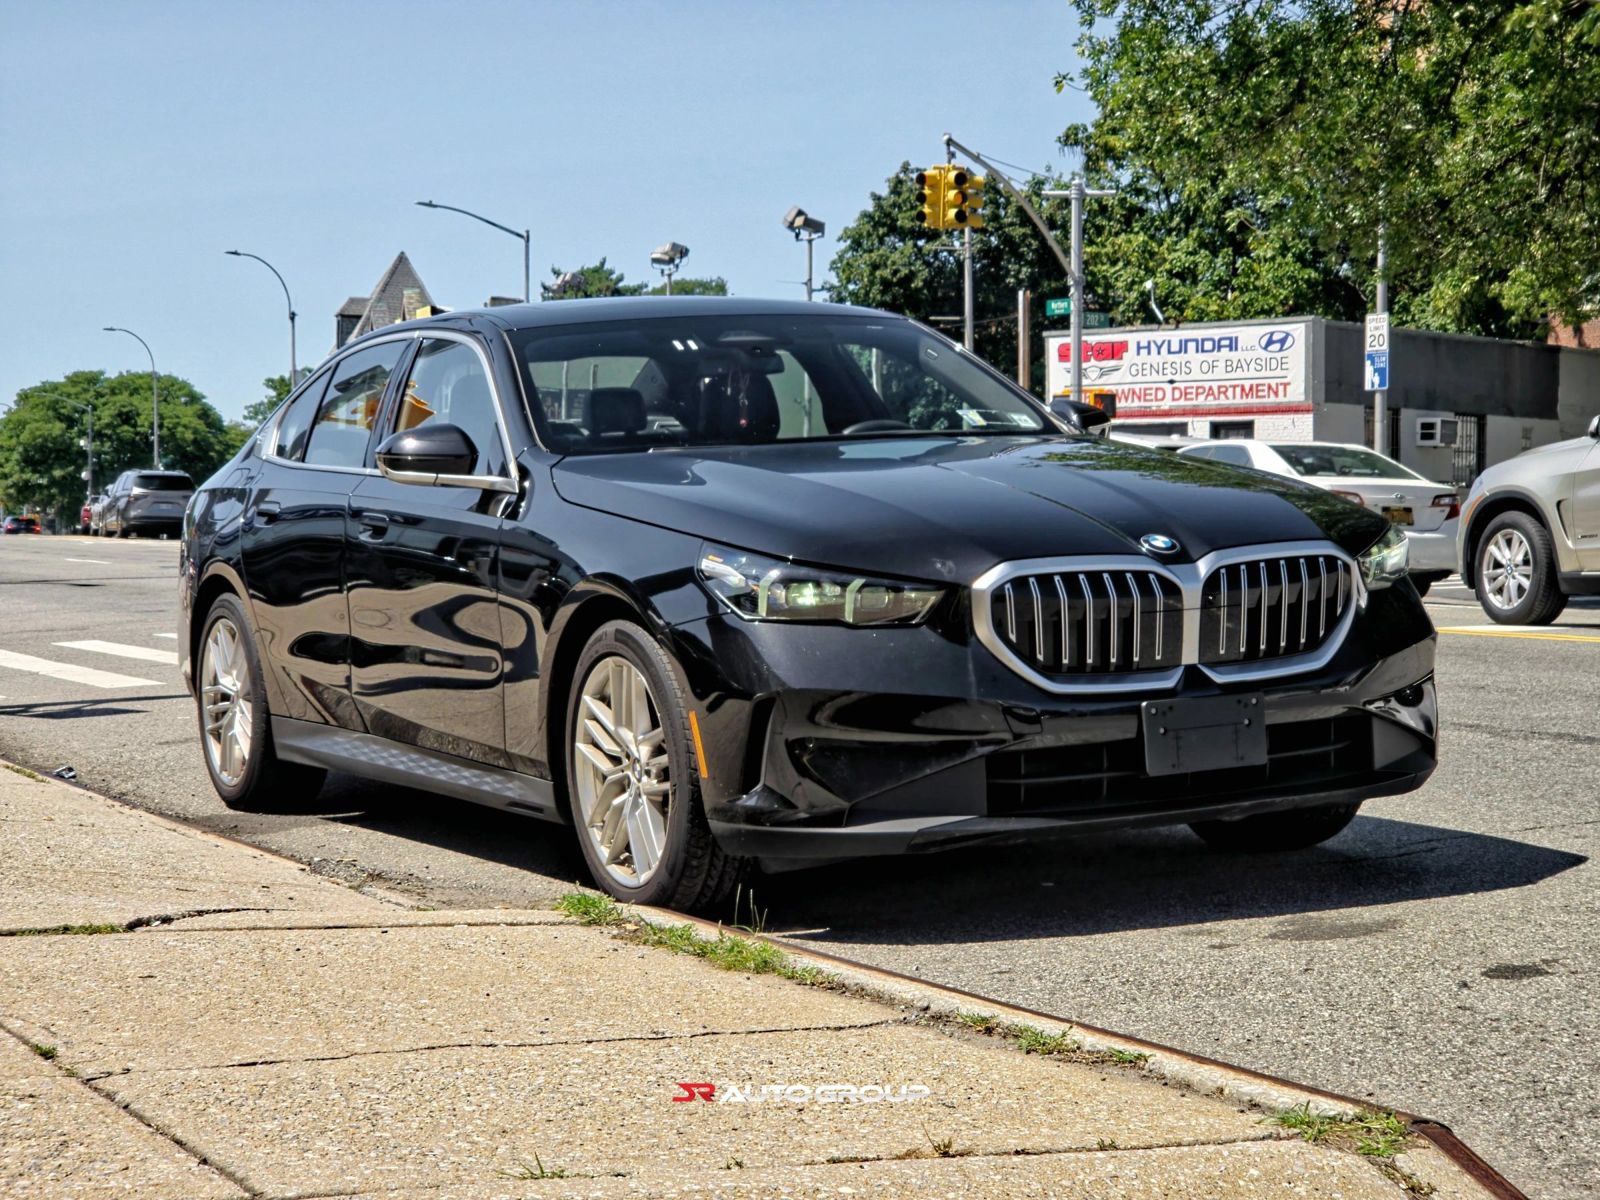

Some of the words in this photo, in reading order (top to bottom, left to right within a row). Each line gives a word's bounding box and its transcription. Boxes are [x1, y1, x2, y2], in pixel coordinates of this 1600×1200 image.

[1136, 335, 1239, 356] HYUNDAI
[1369, 333, 1385, 348] 20
[1129, 360, 1192, 377] GENESIS
[1200, 359, 1220, 375] OF
[1225, 356, 1290, 374] BAYSIDE
[1171, 382, 1291, 401] DEPARTMENT
